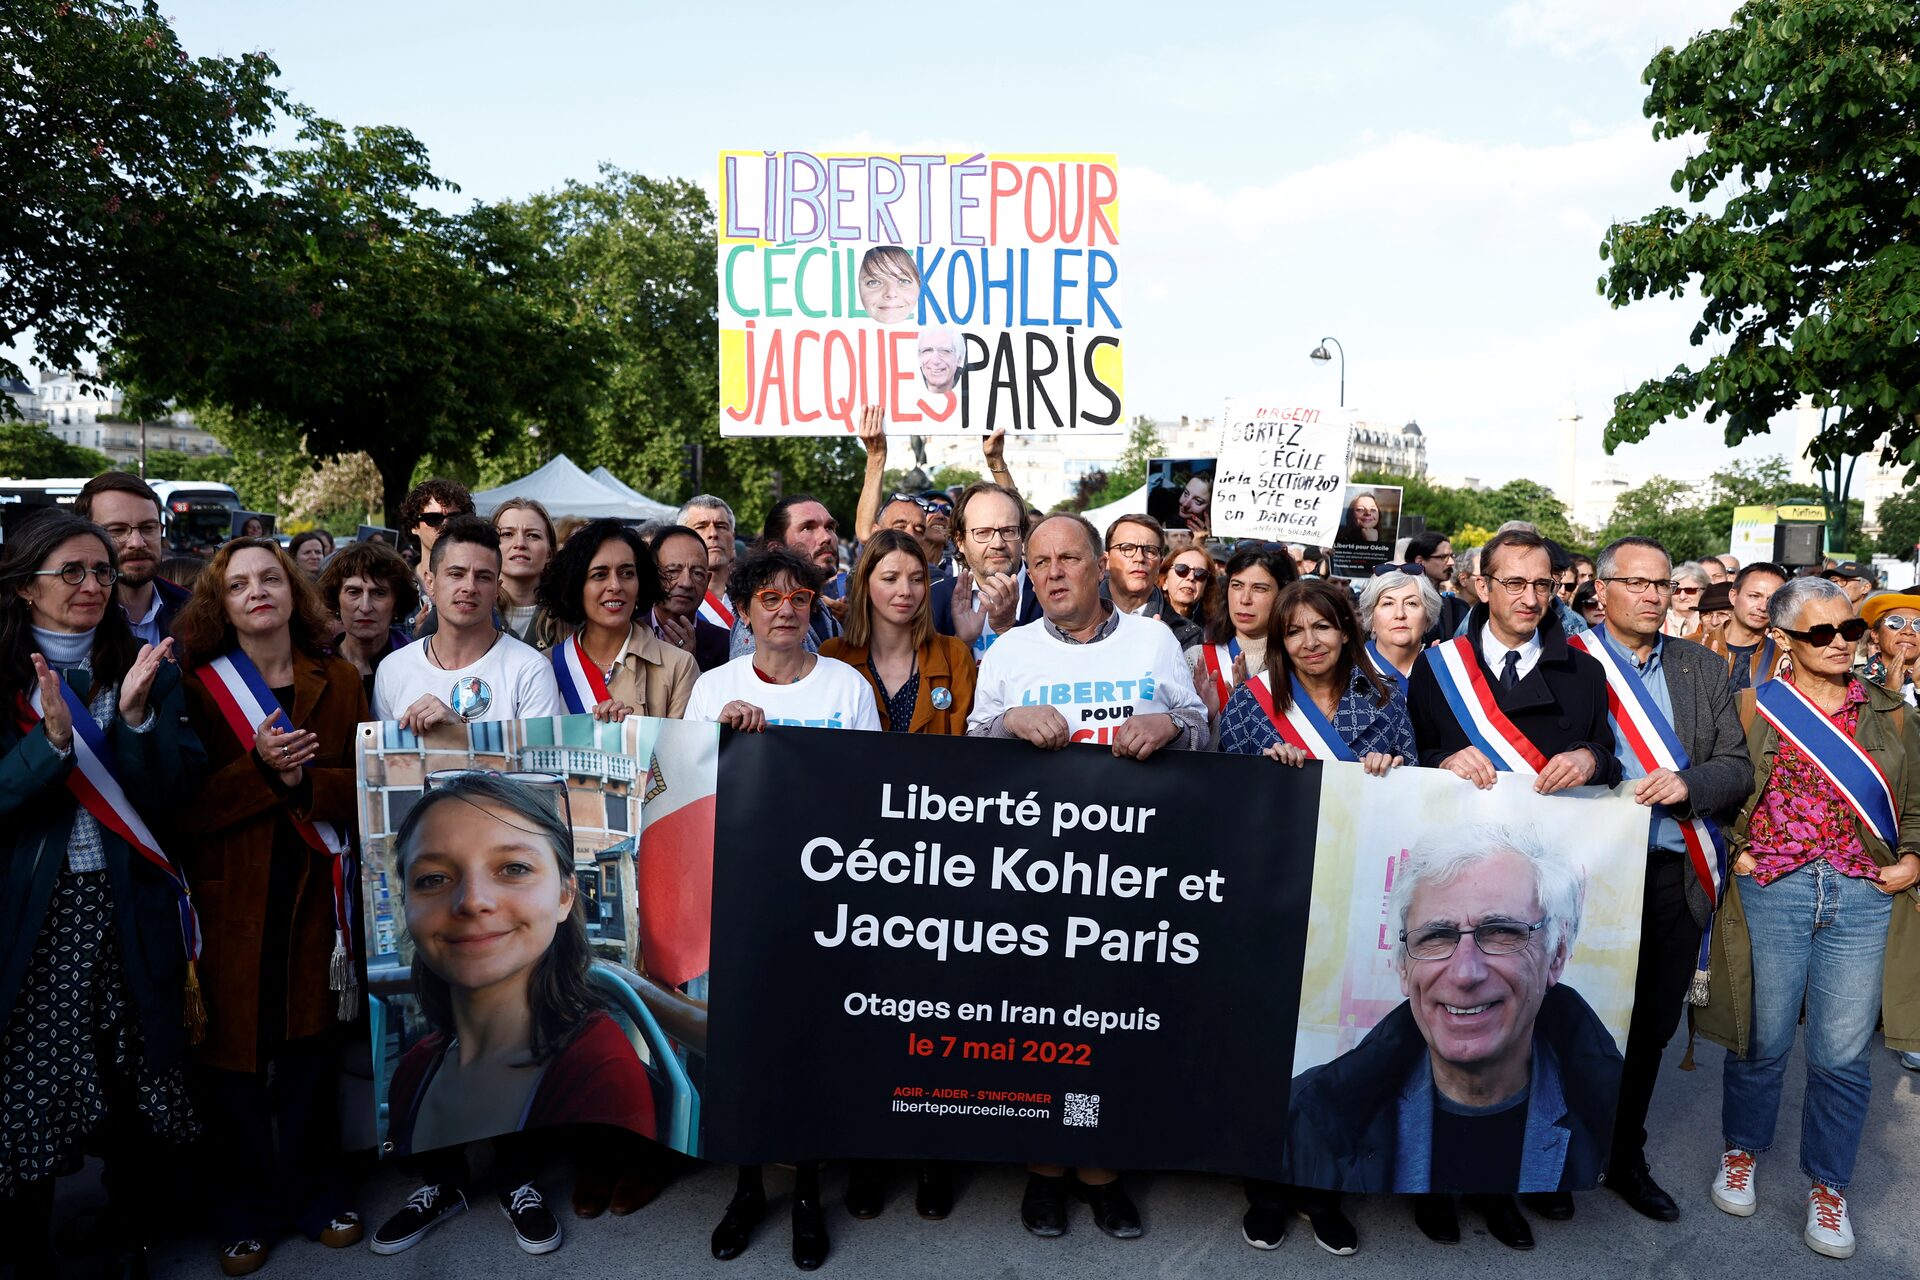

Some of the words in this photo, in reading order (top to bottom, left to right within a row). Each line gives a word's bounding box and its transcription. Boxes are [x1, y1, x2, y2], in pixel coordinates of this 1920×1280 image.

[727, 150, 986, 246] LIBERTÉ
[991, 161, 1118, 246] POUR
[726, 239, 914, 319] CÉCIL
[917, 246, 1122, 328] KOHLER
[961, 326, 1120, 430] PARIS
[1256, 407, 1321, 423] URGENT
[1258, 445, 1327, 470] CÉCILE
[1251, 488, 1285, 508] VIE
[1294, 497, 1321, 511] est
[1314, 474, 1340, 493] 209
[1224, 510, 1244, 521] en
[1257, 509, 1319, 528] DANGER
[1021, 671, 1155, 706] LIBERTÉ
[1081, 705, 1134, 721] POUR
[882, 783, 1041, 827] Liberté
[1052, 802, 1157, 838] pour
[800, 836, 976, 888] Cécile
[991, 846, 1168, 899] Kohler
[1178, 869, 1226, 903] et
[813, 903, 1049, 961] Jacques
[1065, 916, 1200, 965] Paris
[843, 992, 951, 1022] Otages
[957, 1003, 993, 1021] en
[1000, 999, 1056, 1025] Iran
[1062, 1004, 1161, 1034] depuis
[908, 1032, 934, 1057] le
[940, 1037, 957, 1057] 7
[963, 1038, 1016, 1061] mai
[1022, 1040, 1092, 1066] 2022
[892, 1100, 1050, 1119] libertepourcecile.com
[893, 1086, 924, 1097] AGIR
[932, 1088, 968, 1099] AIDER
[977, 1090, 1052, 1104] S'INFORMER
